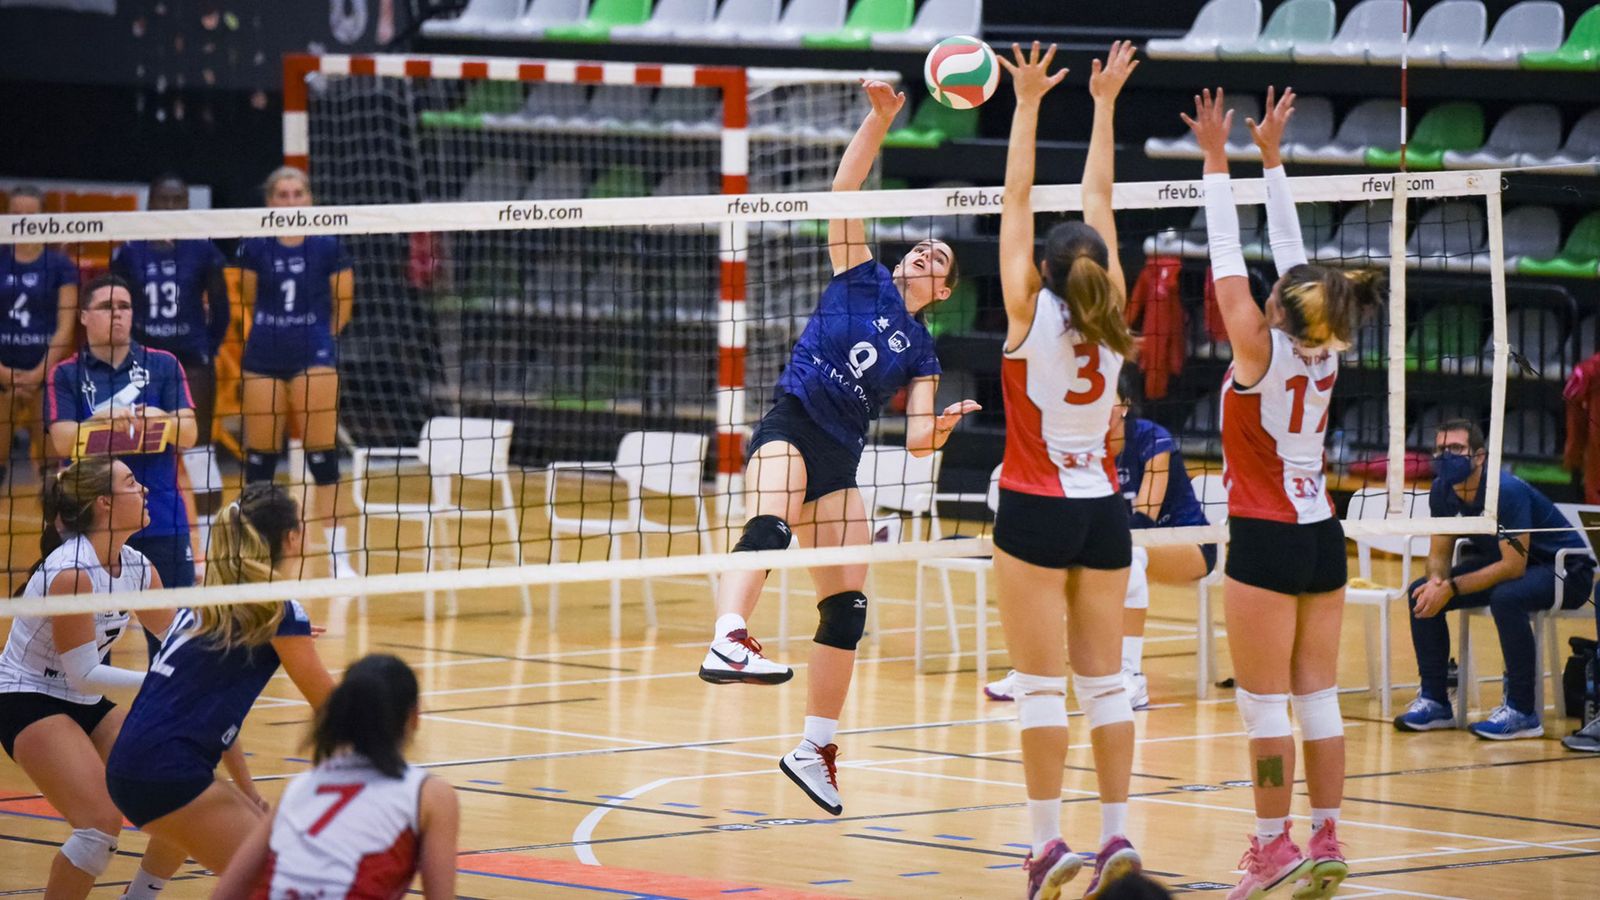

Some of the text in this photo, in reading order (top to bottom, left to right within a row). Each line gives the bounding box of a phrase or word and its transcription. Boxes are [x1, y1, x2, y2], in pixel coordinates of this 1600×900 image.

[1158, 183, 1205, 200] rfevb.
[1362, 176, 1434, 193] rfevcom
[727, 196, 809, 214] rfevb.com
[946, 190, 1005, 207] rfevb.c
[260, 211, 349, 228] rfevb.com
[498, 204, 583, 221] rfevb.com
[11, 216, 104, 236] rfevb.com
[143, 281, 180, 318] 13
[280, 278, 296, 312] 1
[8, 292, 30, 328] 4
[1063, 343, 1106, 405] 3
[1285, 370, 1336, 434] 17
[307, 782, 366, 837] 7
